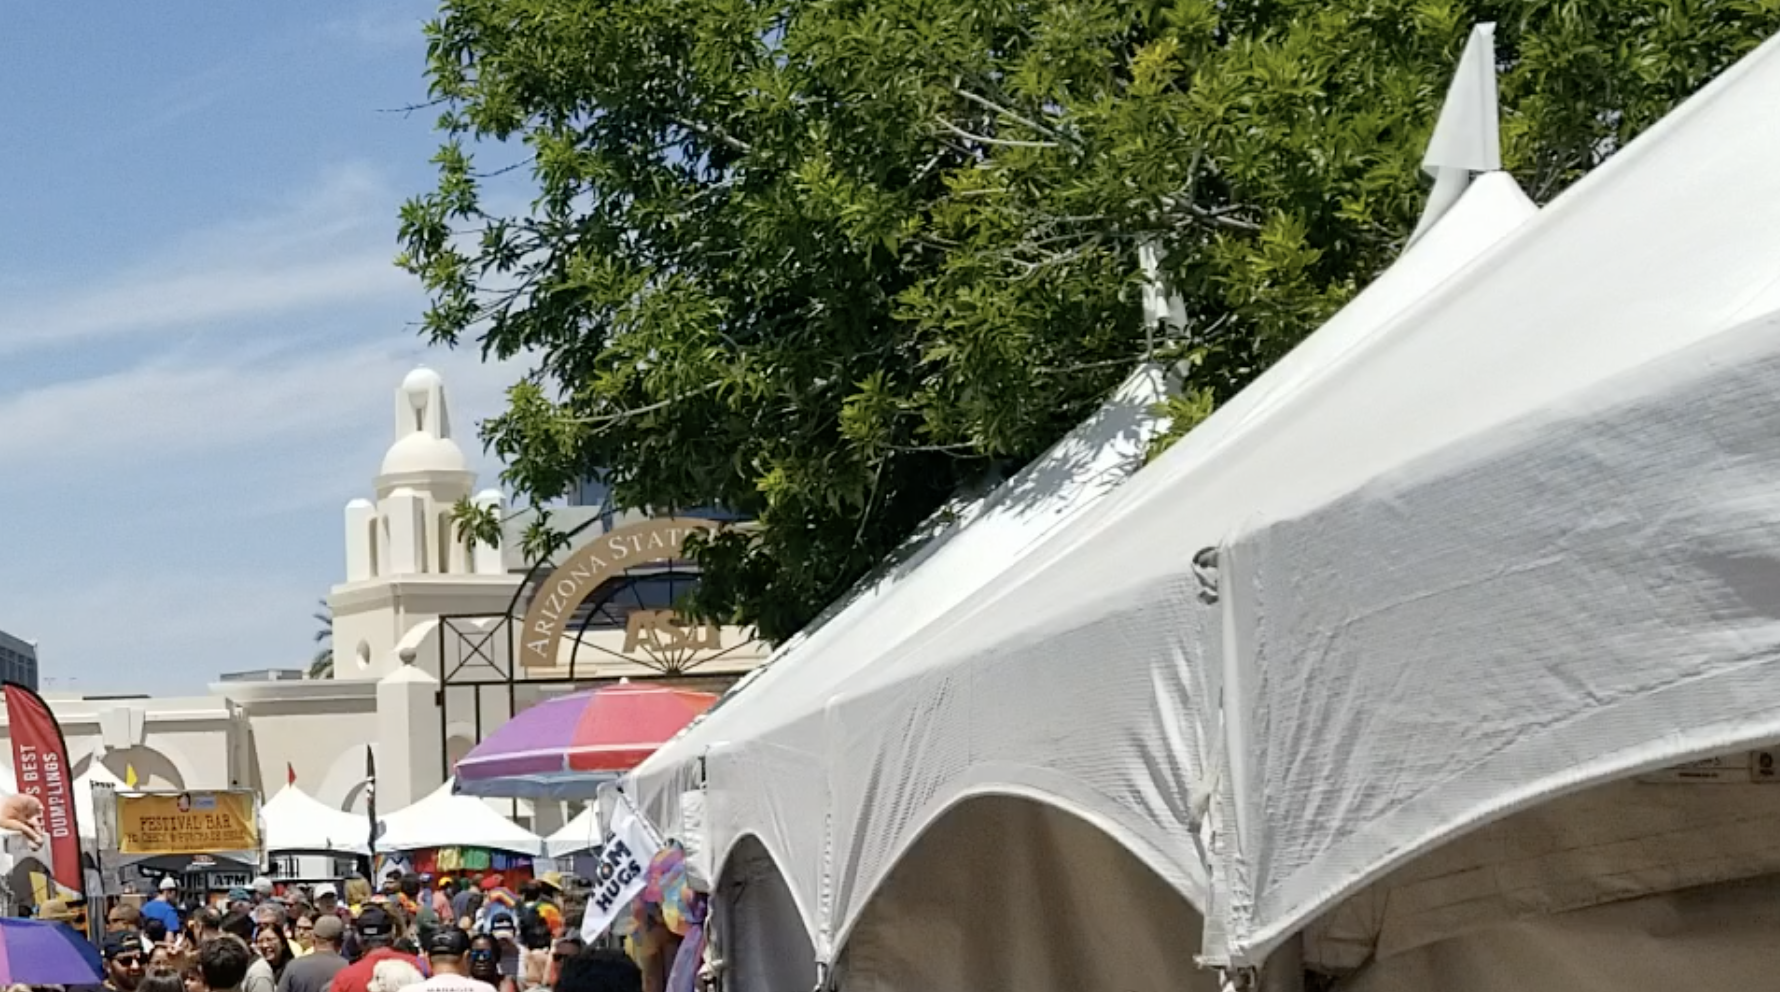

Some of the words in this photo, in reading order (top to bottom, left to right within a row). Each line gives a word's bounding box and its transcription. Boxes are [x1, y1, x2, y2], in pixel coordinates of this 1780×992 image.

[526, 555, 608, 658] ARIZONA
[608, 527, 696, 560] STAT
[20, 744, 39, 782] BEST
[43, 752, 69, 837] DUMPLINGS
[140, 815, 202, 832] FESTIVAL
[205, 813, 232, 830] BAR
[214, 875, 246, 886] ATM
[595, 859, 641, 913] HUGS
